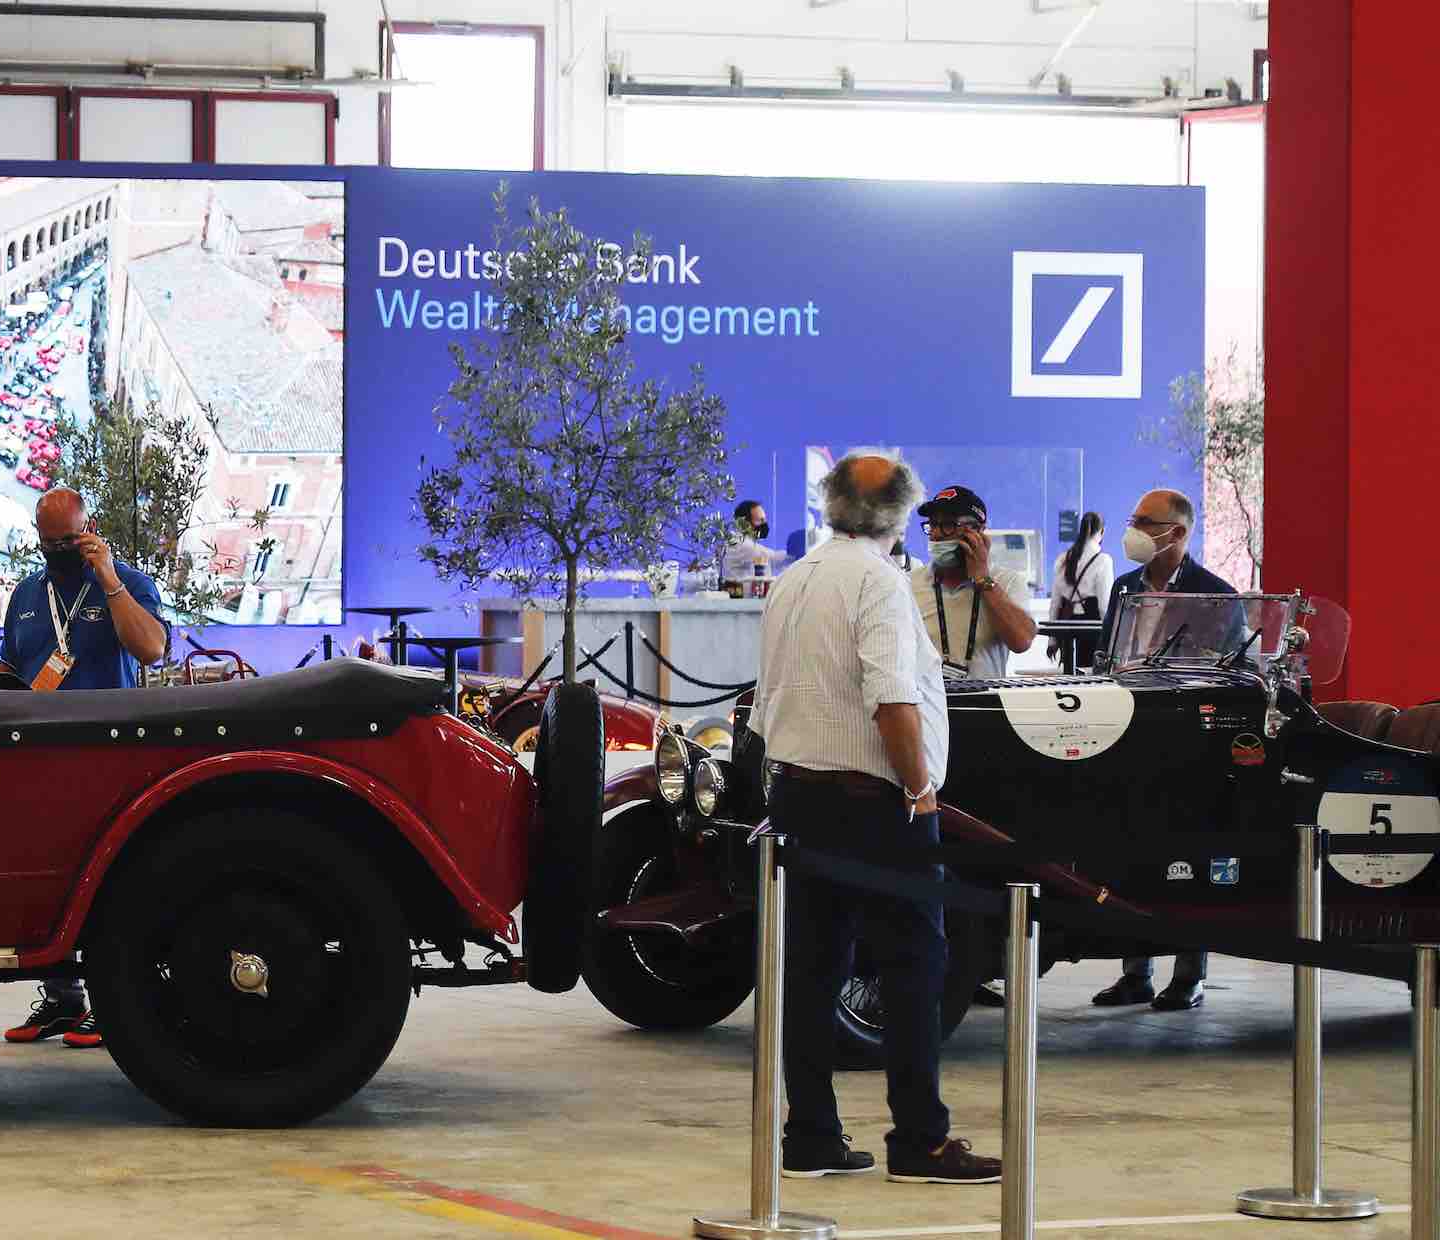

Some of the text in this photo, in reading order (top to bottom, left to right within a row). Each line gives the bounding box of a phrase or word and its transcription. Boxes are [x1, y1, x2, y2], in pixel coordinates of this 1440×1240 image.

[377, 236, 579, 281] Deutsce
[376, 288, 525, 332] Wealt
[1369, 803, 1392, 841] 5
